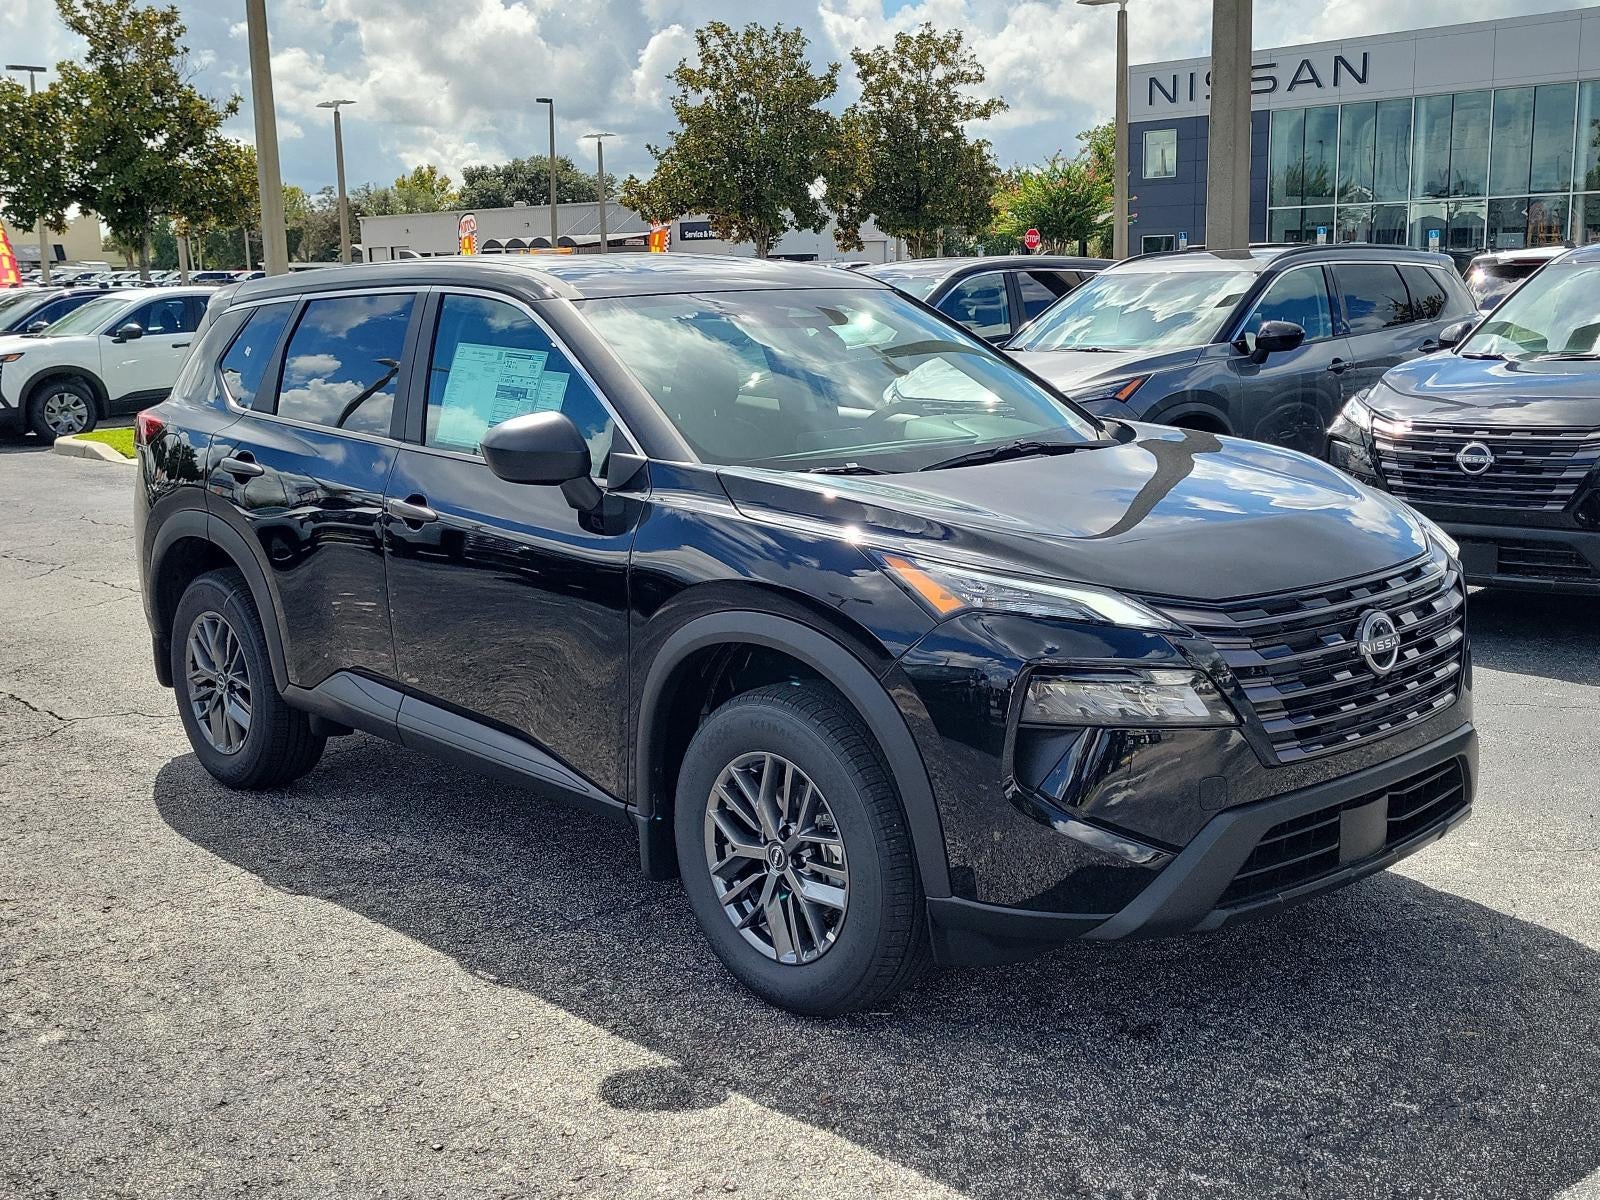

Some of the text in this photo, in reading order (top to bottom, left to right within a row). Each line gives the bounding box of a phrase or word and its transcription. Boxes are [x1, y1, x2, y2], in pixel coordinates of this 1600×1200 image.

[1148, 52, 1369, 106] NISAN
[1456, 454, 1494, 463] NISSAN
[1362, 635, 1400, 653] NISSAN
